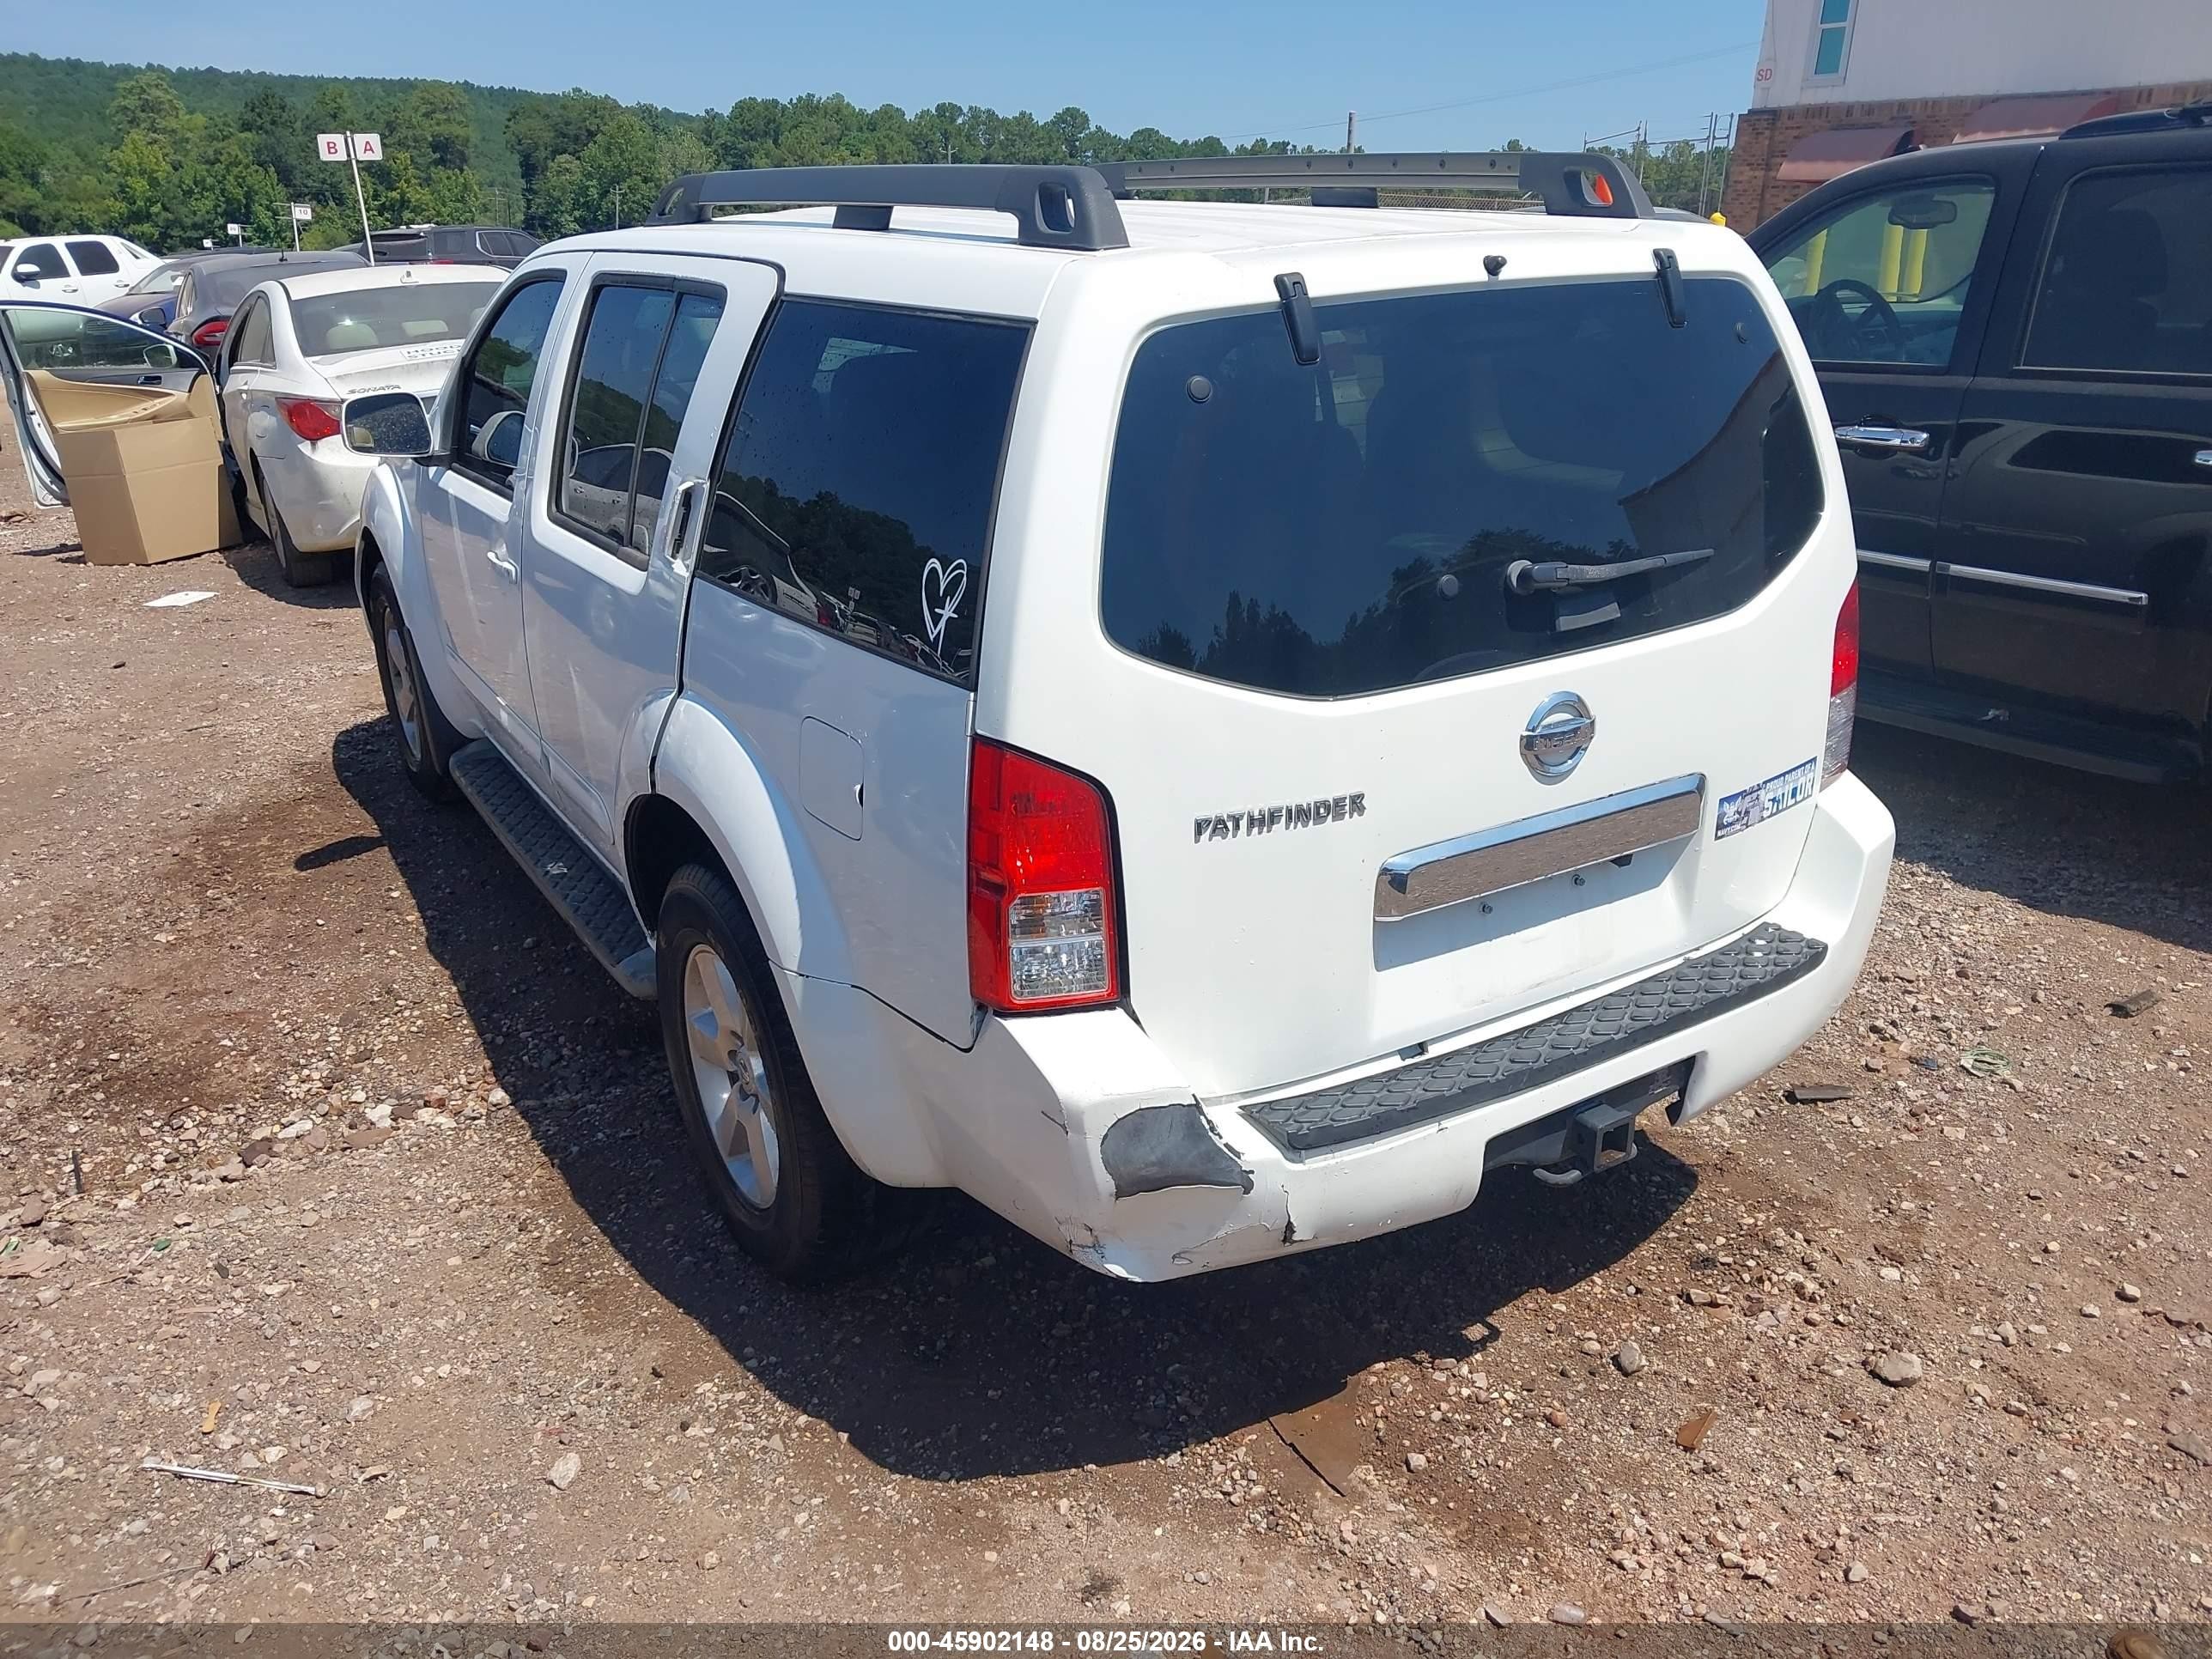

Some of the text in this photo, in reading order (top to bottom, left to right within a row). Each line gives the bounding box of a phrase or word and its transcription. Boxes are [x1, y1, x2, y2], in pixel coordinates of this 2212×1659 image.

[1756, 68, 1773, 82] SD
[326, 141, 338, 155] B
[363, 140, 375, 154] A
[407, 349, 461, 358] STUC
[347, 385, 402, 395] SONATA
[1765, 776, 1784, 792] PROUD
[1785, 767, 1805, 782] PARENT
[1763, 774, 1815, 817] SAILOR
[1194, 792, 1366, 842] PATHFINDER
